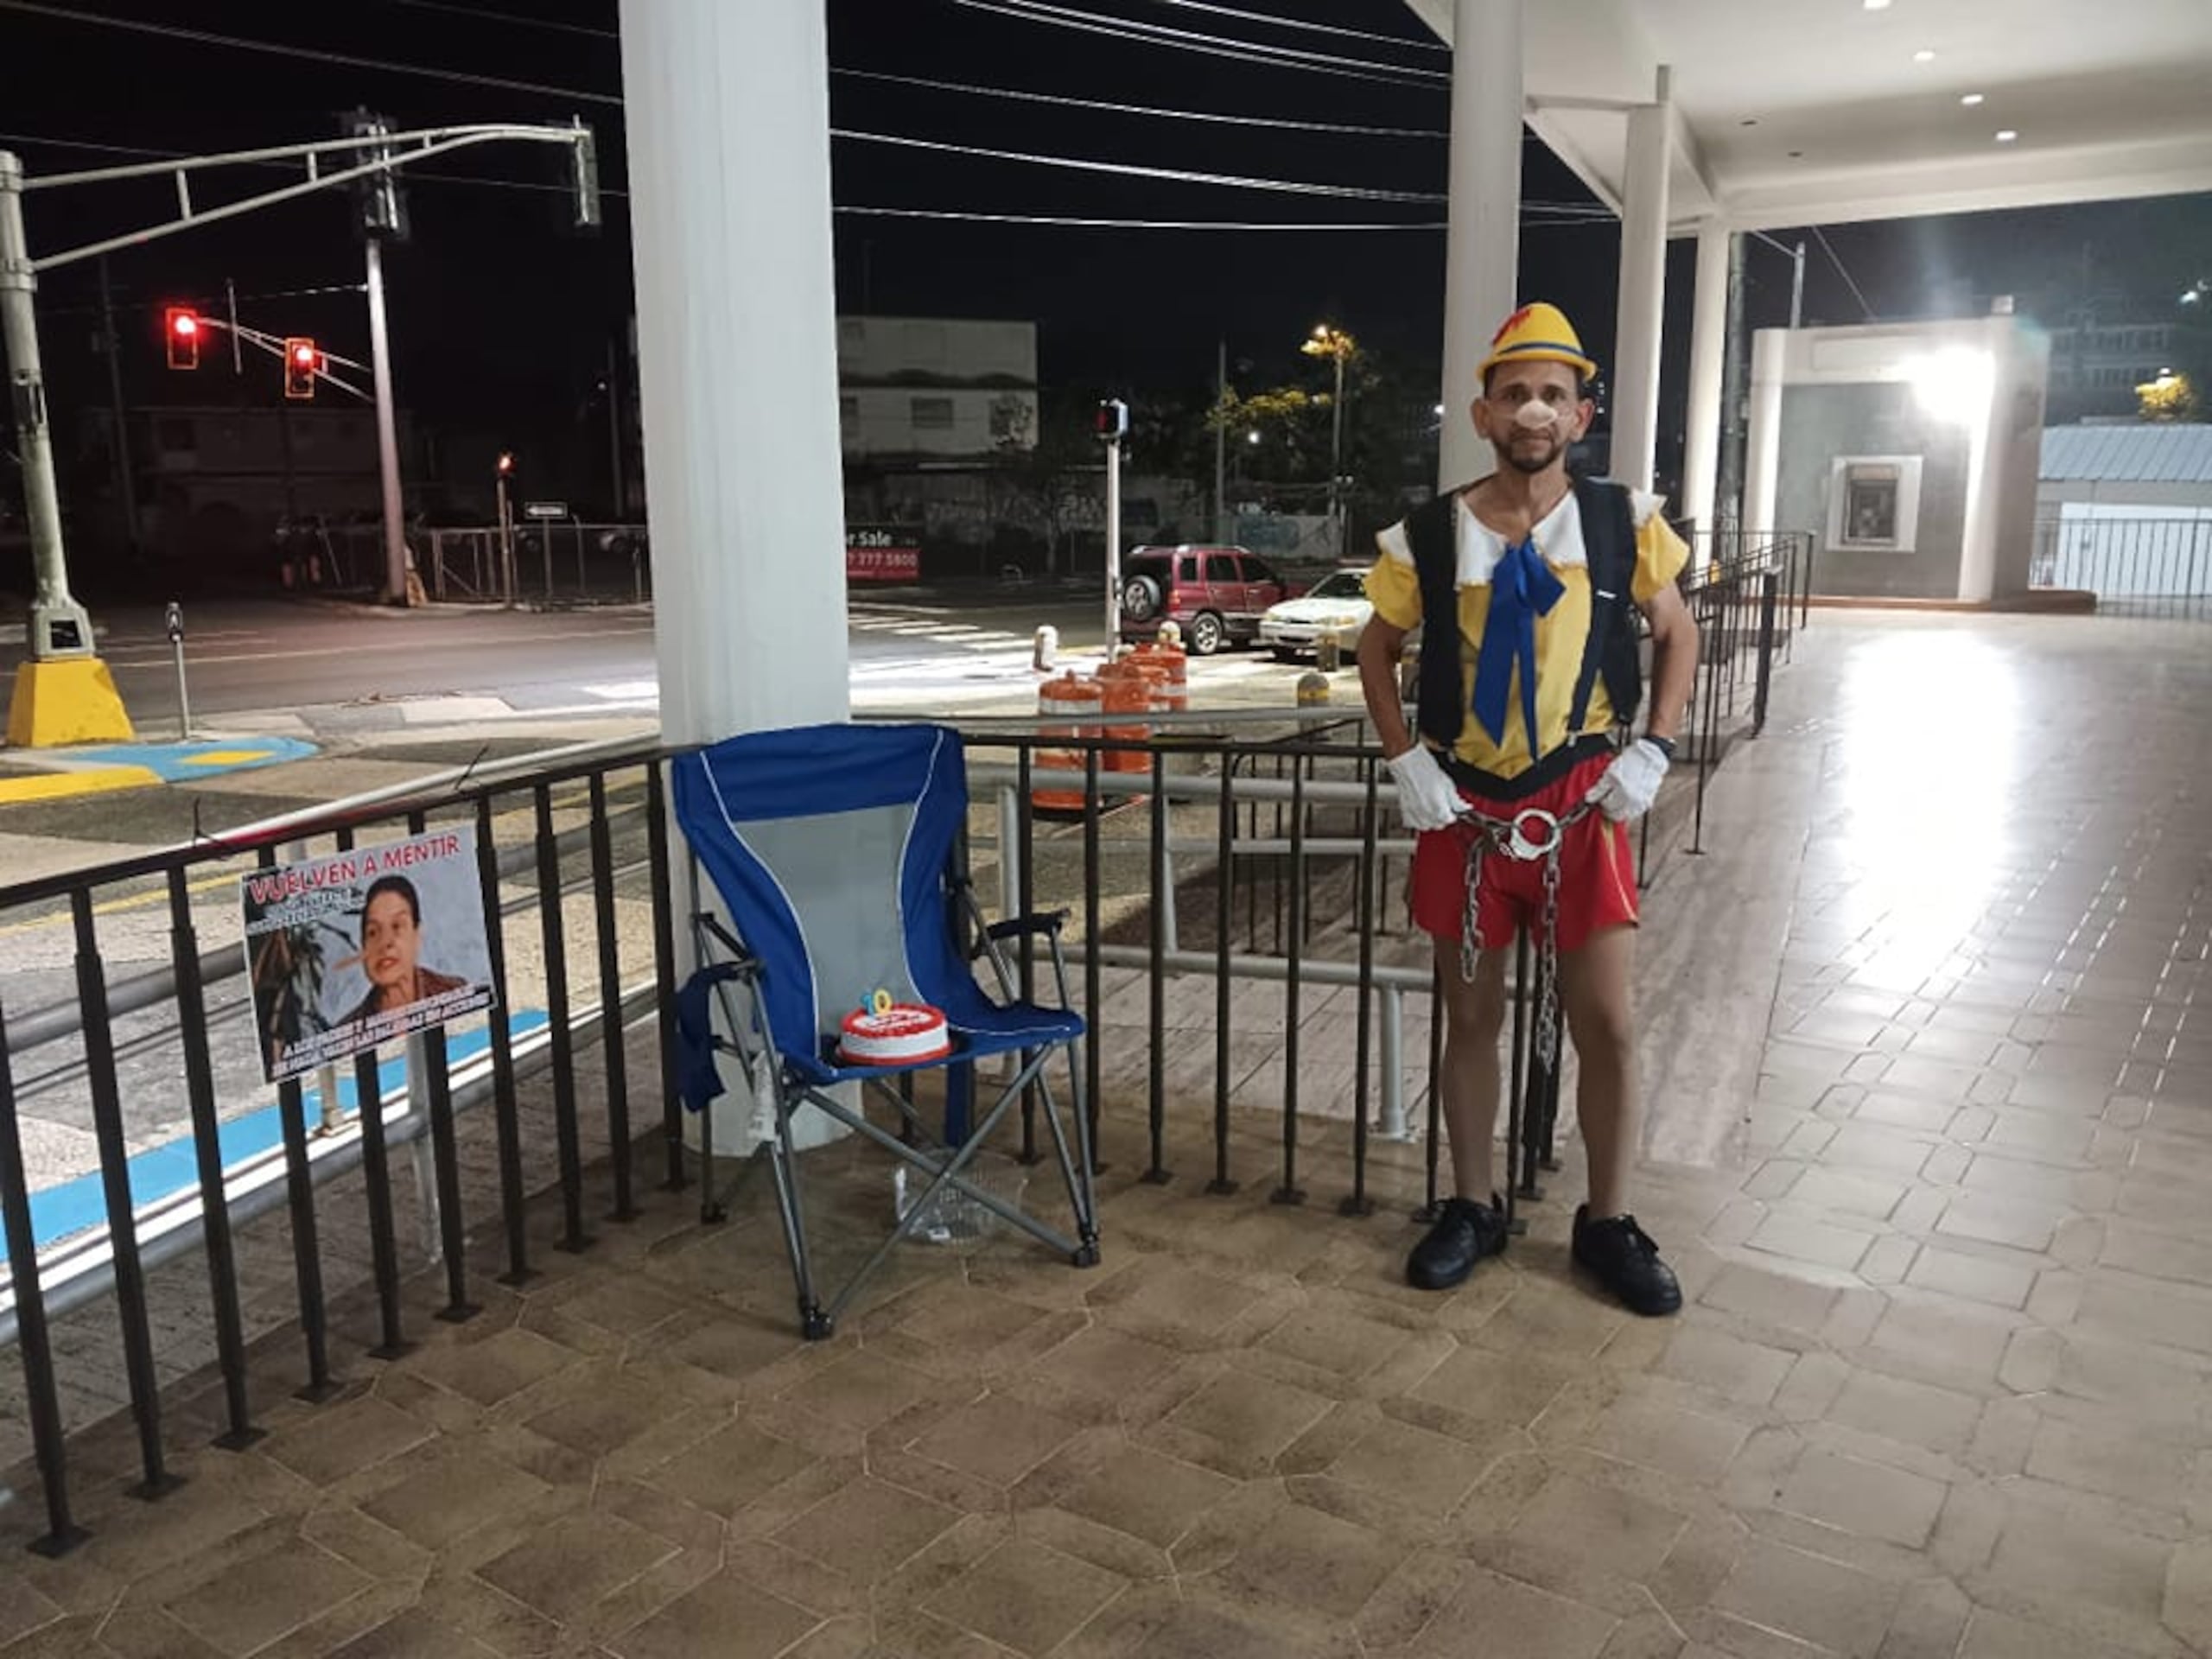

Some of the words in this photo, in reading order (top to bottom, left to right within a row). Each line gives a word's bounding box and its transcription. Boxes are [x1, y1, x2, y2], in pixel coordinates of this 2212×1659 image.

[858, 530, 892, 547] Sale
[250, 861, 356, 903] VUELVEN
[363, 852, 378, 877] A
[383, 833, 461, 868] MENTIR
